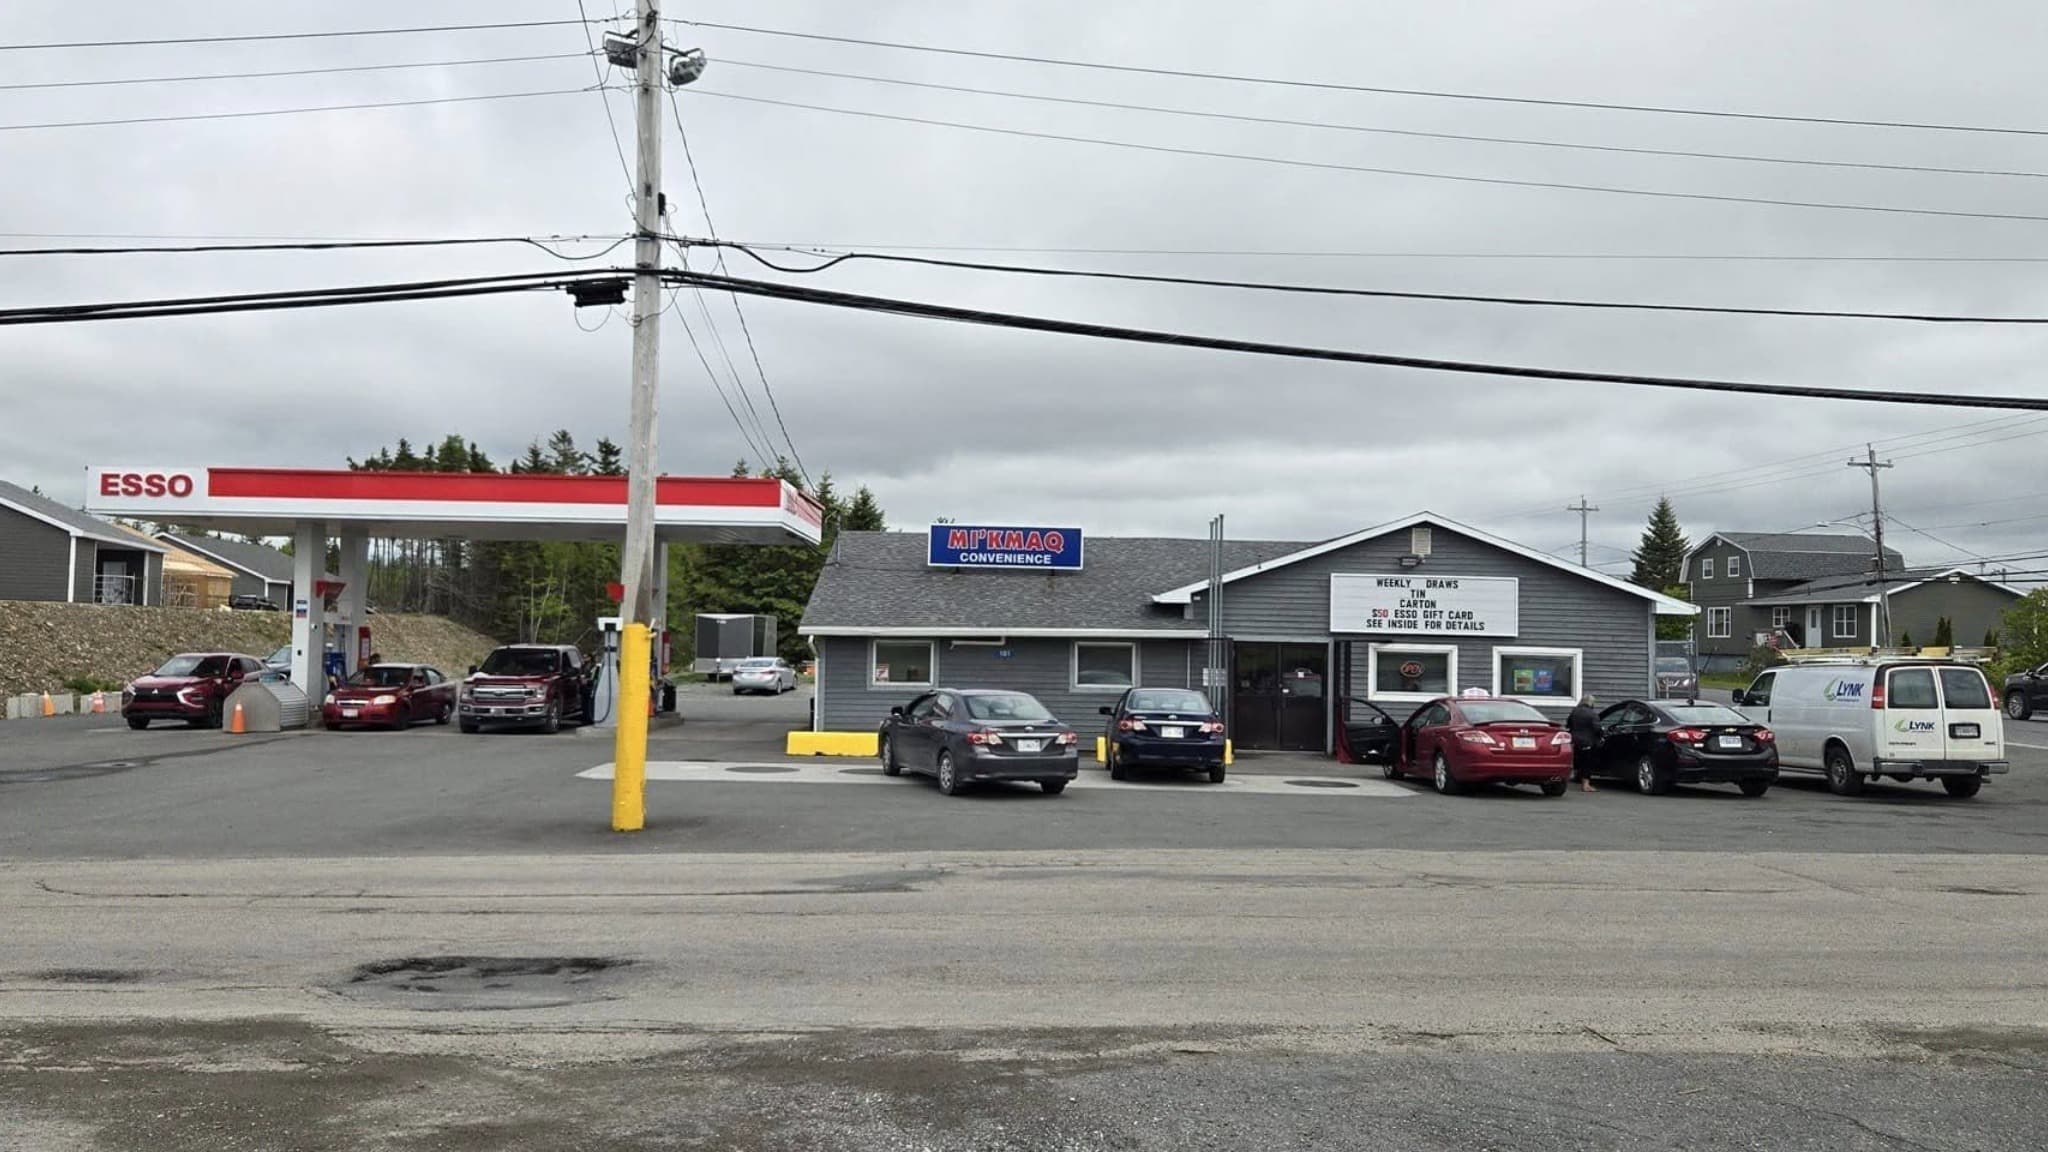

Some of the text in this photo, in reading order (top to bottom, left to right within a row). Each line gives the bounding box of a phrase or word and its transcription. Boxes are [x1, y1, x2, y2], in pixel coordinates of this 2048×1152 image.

[100, 473, 193, 498] ESSO
[948, 528, 1064, 554] MI'KMAQ
[959, 552, 1052, 565] CONVENIENCE
[1376, 578, 1459, 589] WEEKLY DRAWS
[1411, 589, 1426, 599] TIN
[1400, 599, 1437, 609] CARTON
[1394, 609, 1418, 619] ESSO
[1423, 610, 1444, 619] GIFT
[1448, 610, 1474, 620] CARD
[1366, 619, 1485, 631] SEE INSIDE FOR DETAILS
[1836, 680, 1865, 697] LYNK
[1909, 720, 1936, 730] LYNK
